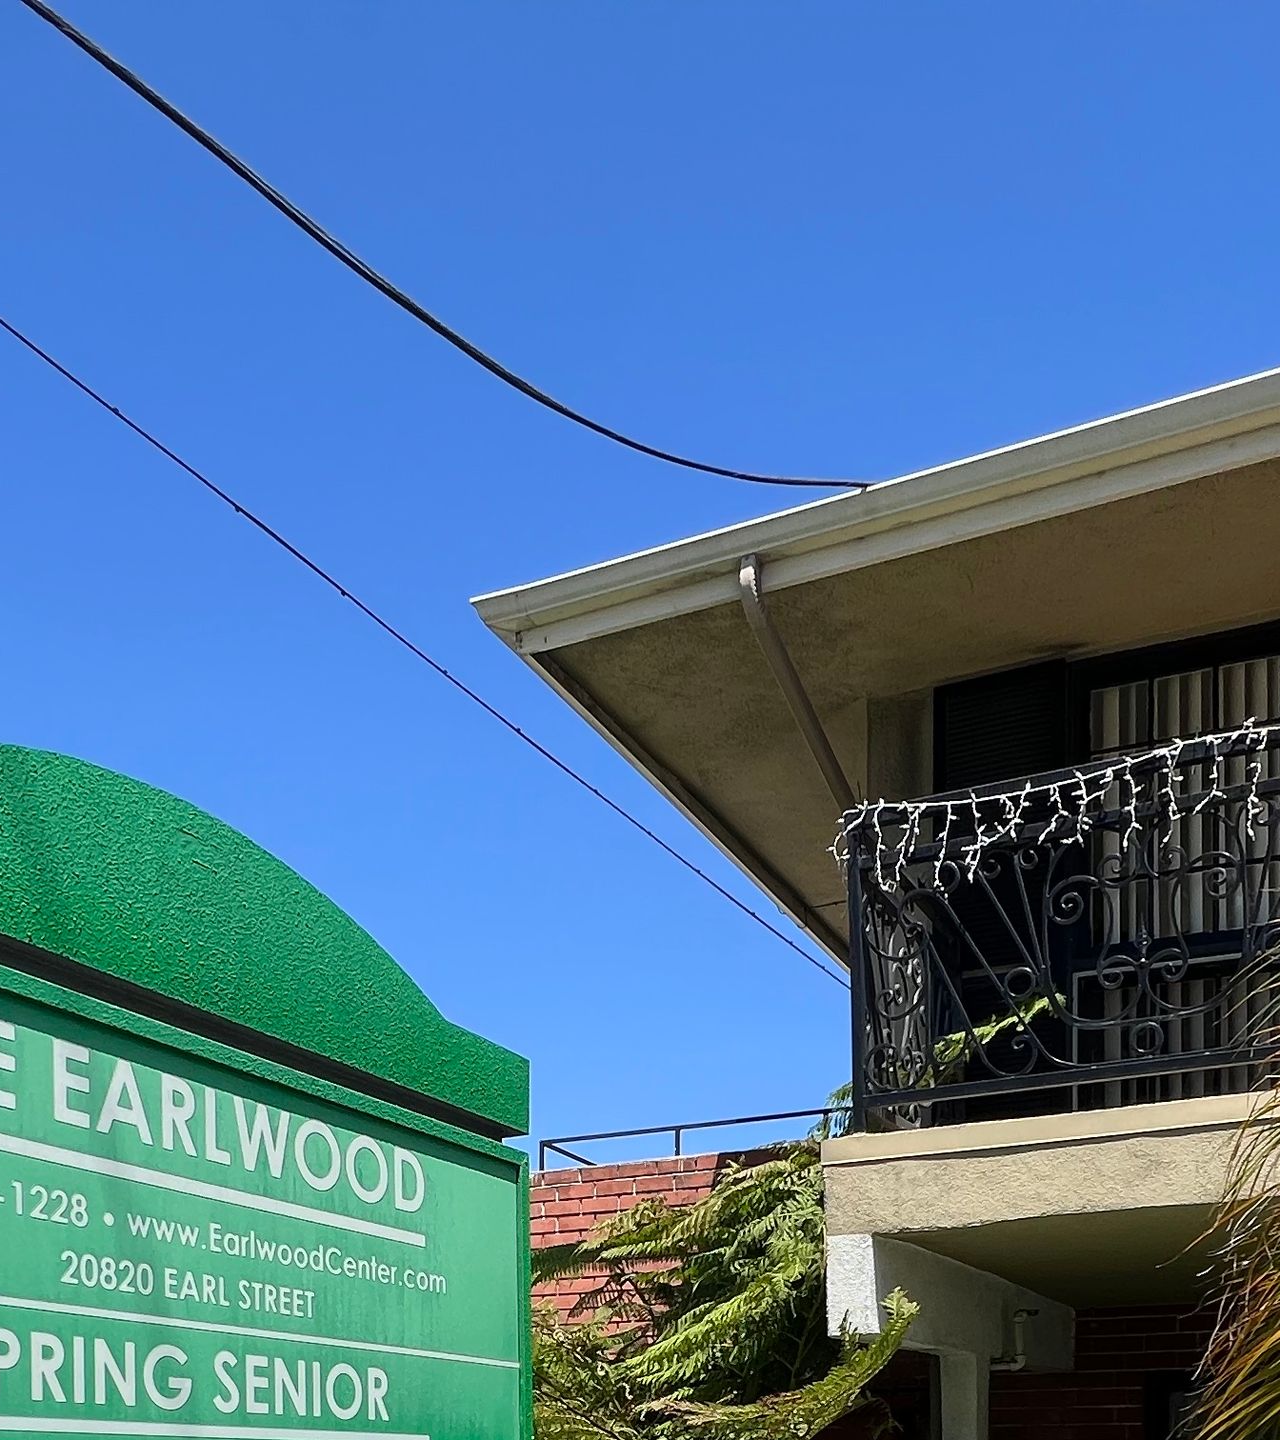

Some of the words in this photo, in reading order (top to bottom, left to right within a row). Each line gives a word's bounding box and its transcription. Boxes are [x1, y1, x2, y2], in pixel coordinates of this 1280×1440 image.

[47, 1034, 425, 1212] EARLWOOD
[60, 1250, 154, 1295] 20820
[164, 1267, 230, 1307] EARL
[238, 1279, 315, 1318] STREET
[127, 1213, 446, 1294] www.EarlwoodCenter.com
[212, 1350, 389, 1421] SENIOR
